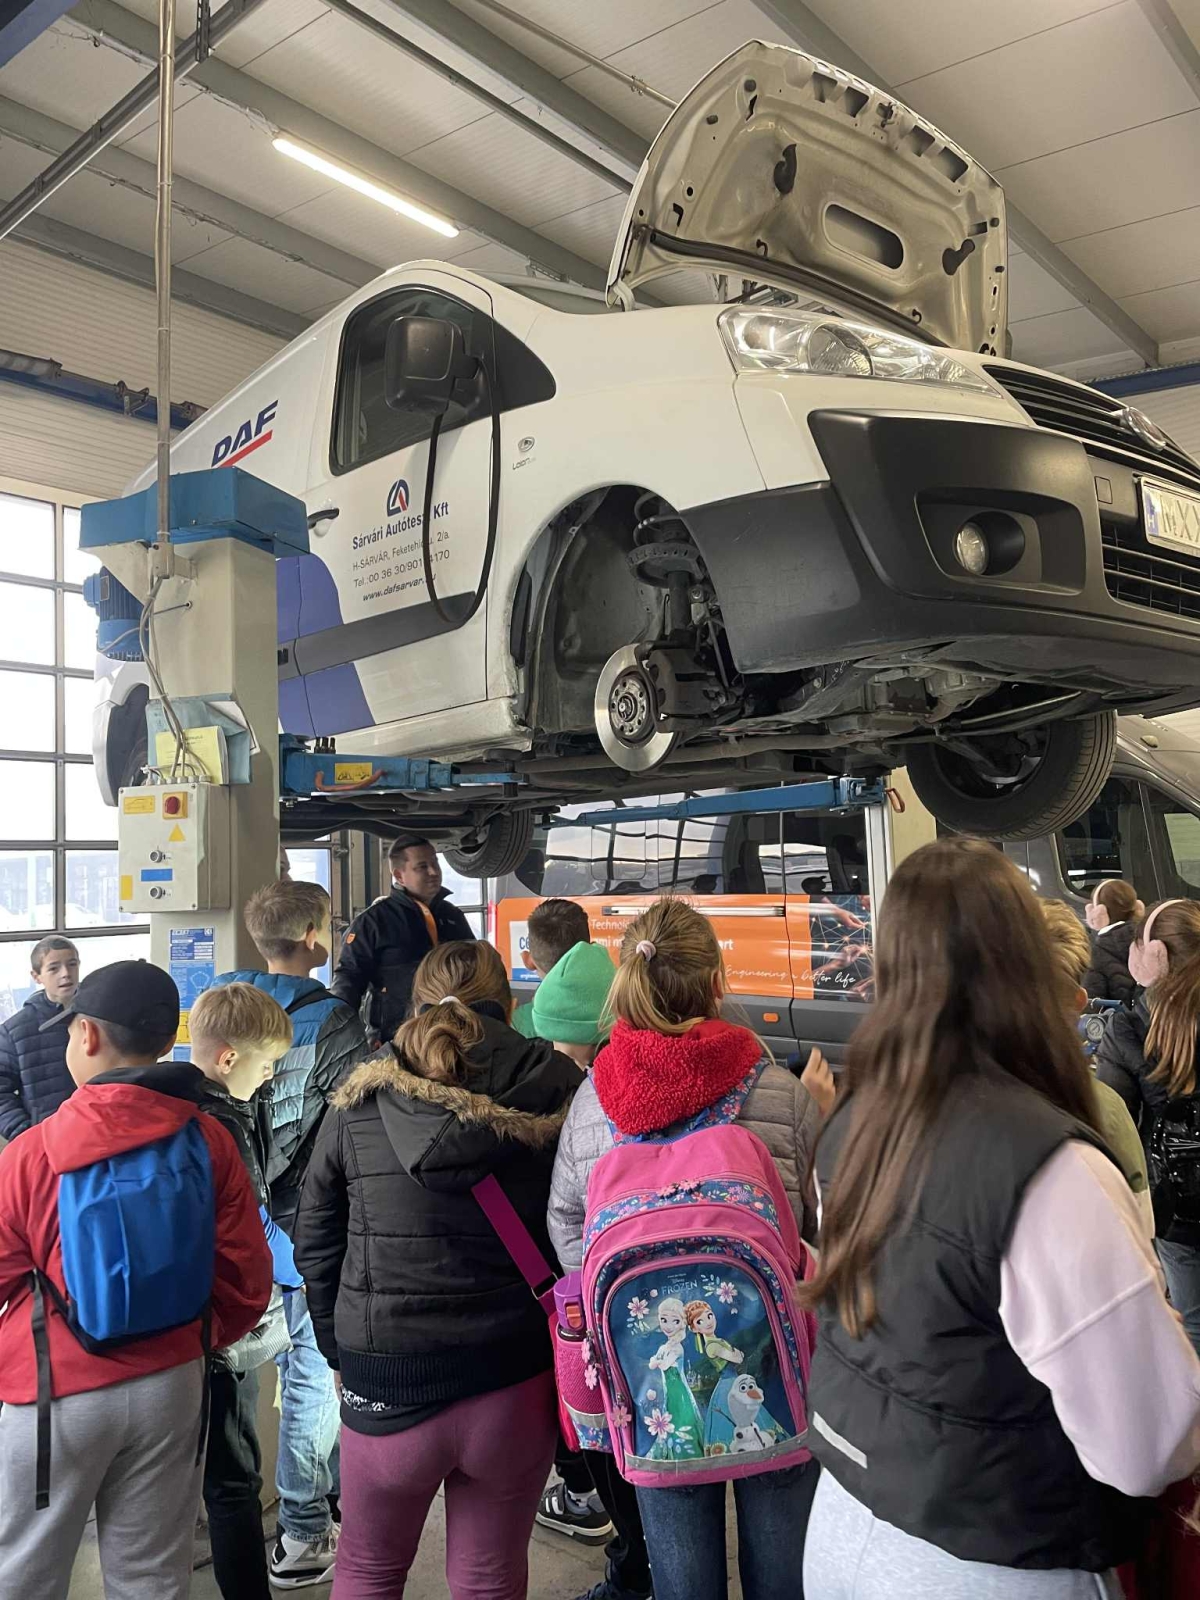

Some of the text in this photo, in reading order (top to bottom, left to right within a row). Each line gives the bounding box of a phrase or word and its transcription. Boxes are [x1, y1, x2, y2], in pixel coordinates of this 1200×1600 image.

[211, 399, 279, 468] DAF
[352, 502, 449, 550] Sárvári Autótes Kft
[381, 568, 392, 580] 36
[362, 573, 437, 602] www.dafsarvar.u
[724, 964, 789, 981] Engineering
[799, 968, 831, 985] better
[834, 966, 856, 988] life
[661, 1279, 698, 1295] FROZEN
